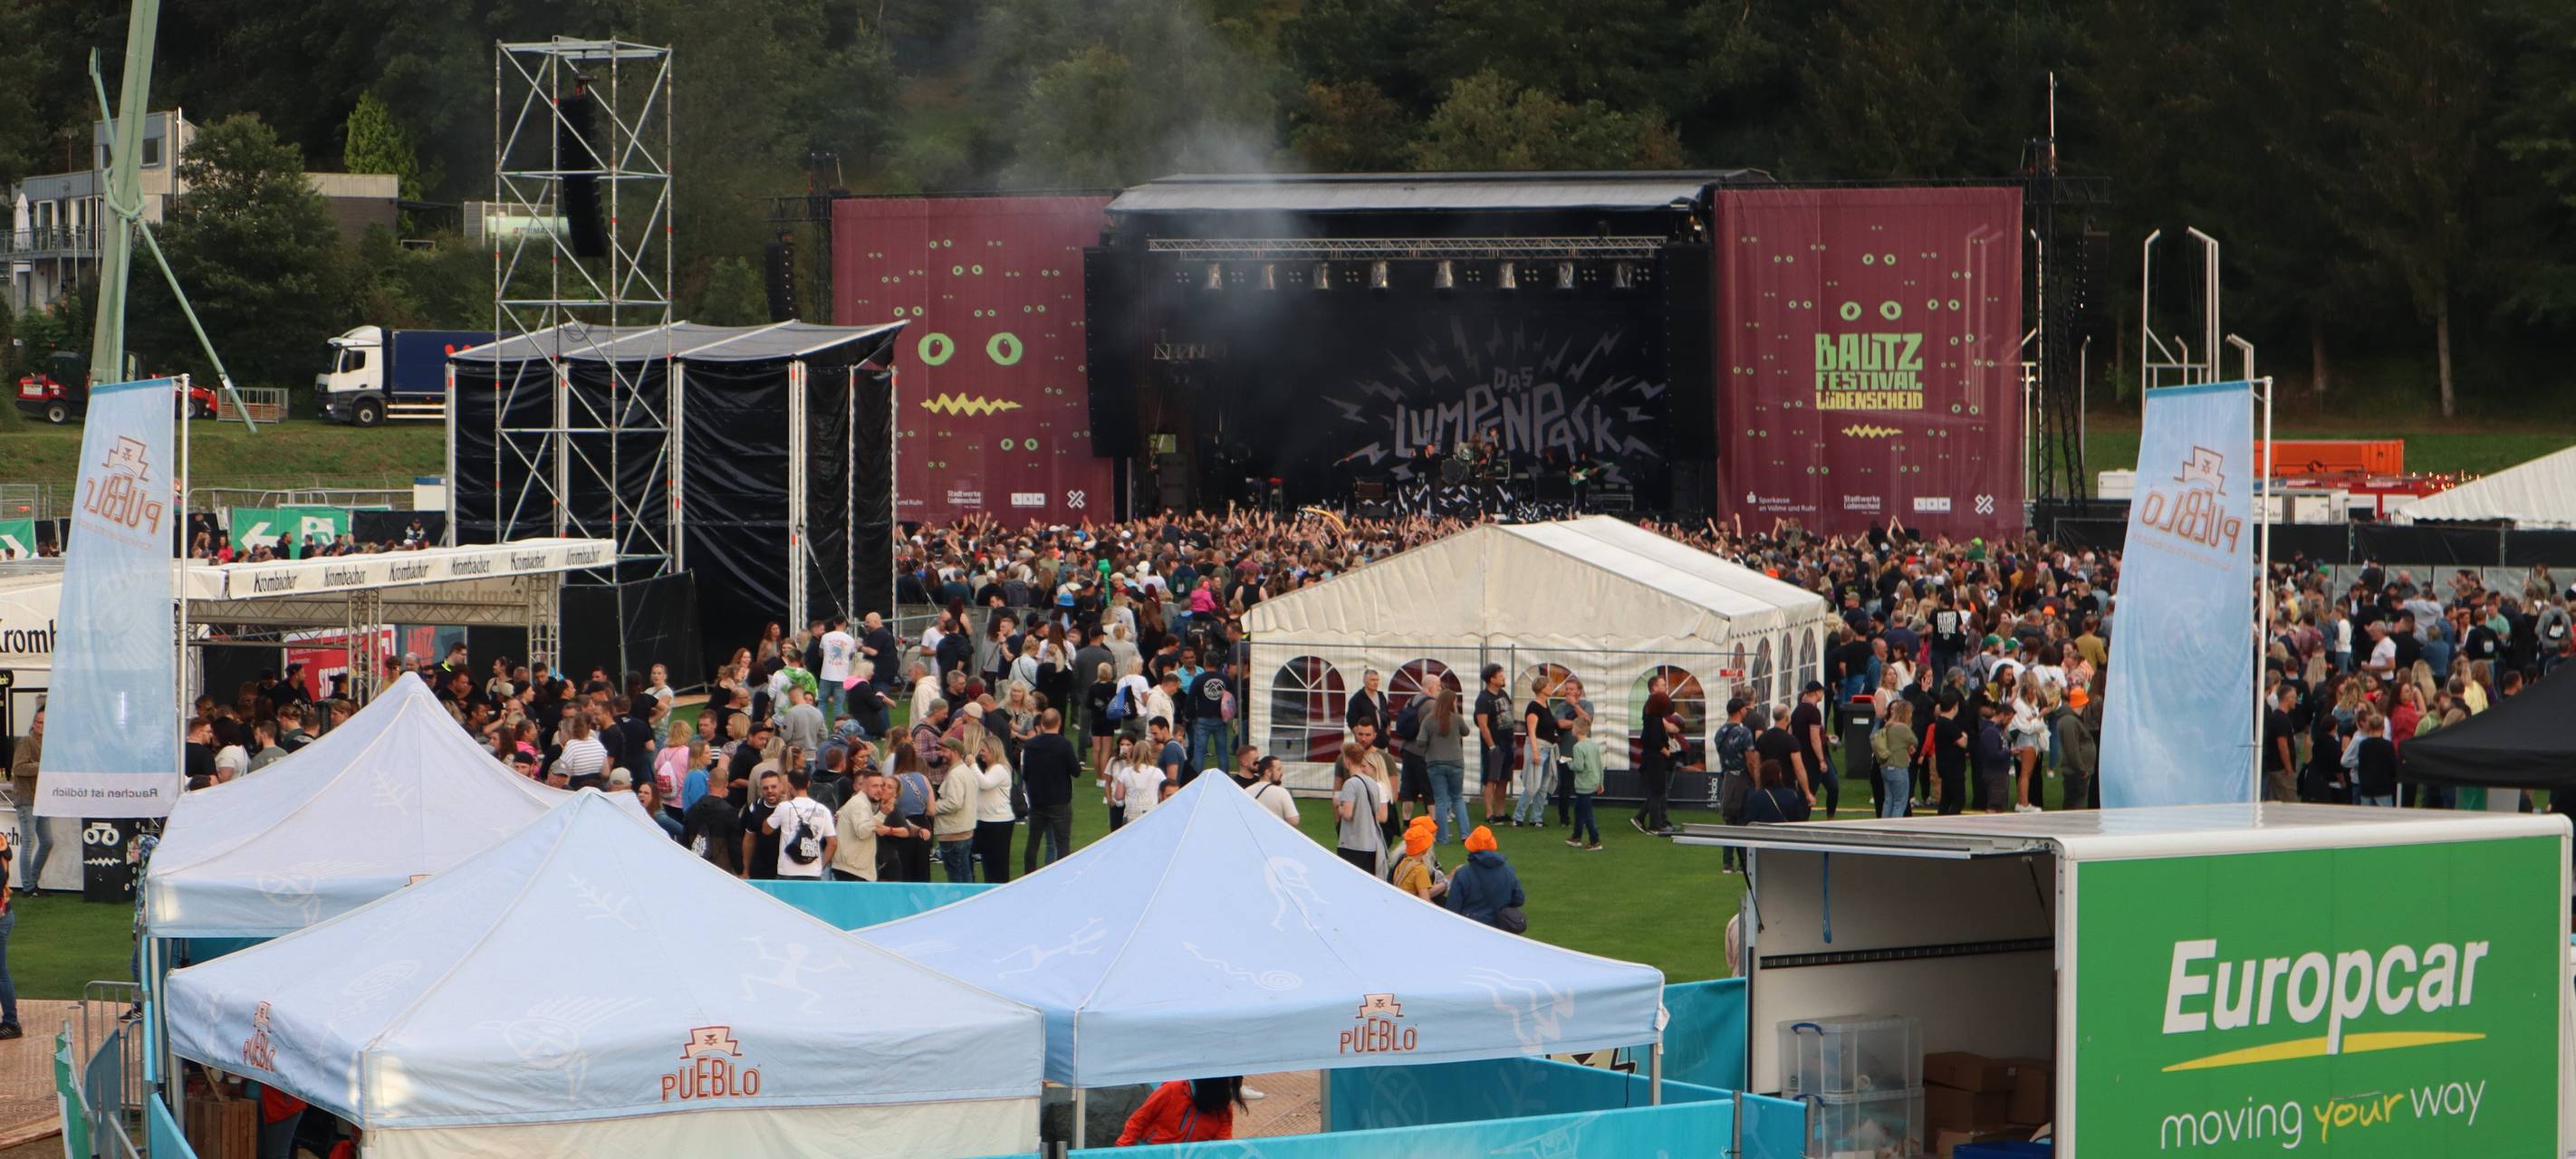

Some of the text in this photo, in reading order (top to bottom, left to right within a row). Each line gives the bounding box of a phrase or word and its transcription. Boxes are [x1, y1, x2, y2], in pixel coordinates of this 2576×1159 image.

[1814, 332, 1923, 370] BAUTZ
[1495, 366, 1533, 392] DAS
[1815, 371, 1923, 390] FESTIVAL
[1815, 391, 1923, 410] LÜDENSCHEID
[1758, 496, 1790, 504] Sparkasse
[253, 570, 297, 593] Krombacher
[323, 565, 367, 588] Krombacher
[389, 561, 428, 581] Krombacher
[2162, 938, 2489, 1055] Europcar
[1340, 1016, 1417, 1055] PUEBLO
[660, 1055, 760, 1102] PUEBLO
[2161, 1079, 2485, 1150] moving your way
